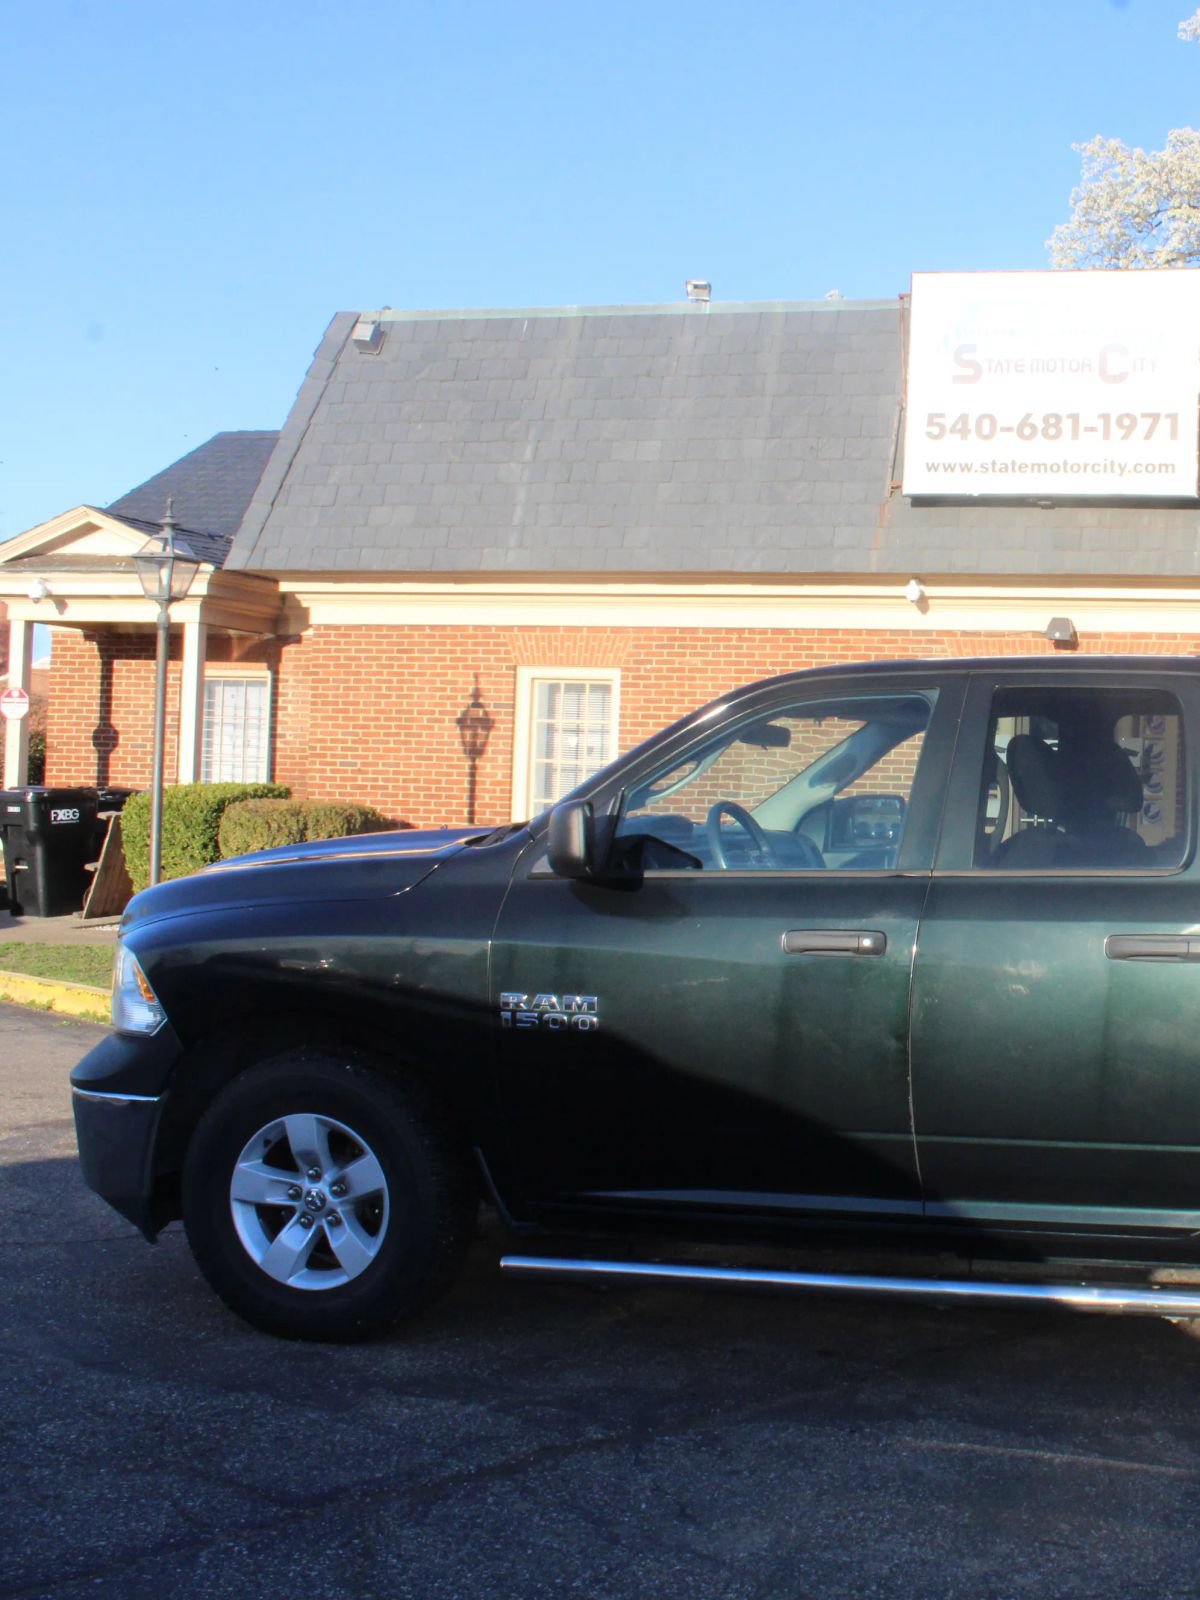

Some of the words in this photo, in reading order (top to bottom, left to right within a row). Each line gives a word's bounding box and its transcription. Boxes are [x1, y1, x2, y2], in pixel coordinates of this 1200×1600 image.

[953, 344, 1025, 384] STATE
[1030, 357, 1092, 373] MOTOR
[1099, 344, 1159, 384] CITY
[925, 412, 1179, 441] 540-681-1971
[925, 458, 1176, 477] www.statemotorcity.com
[51, 808, 79, 821] FXBG
[500, 992, 598, 1012] RAM
[501, 1011, 599, 1030] 1500
